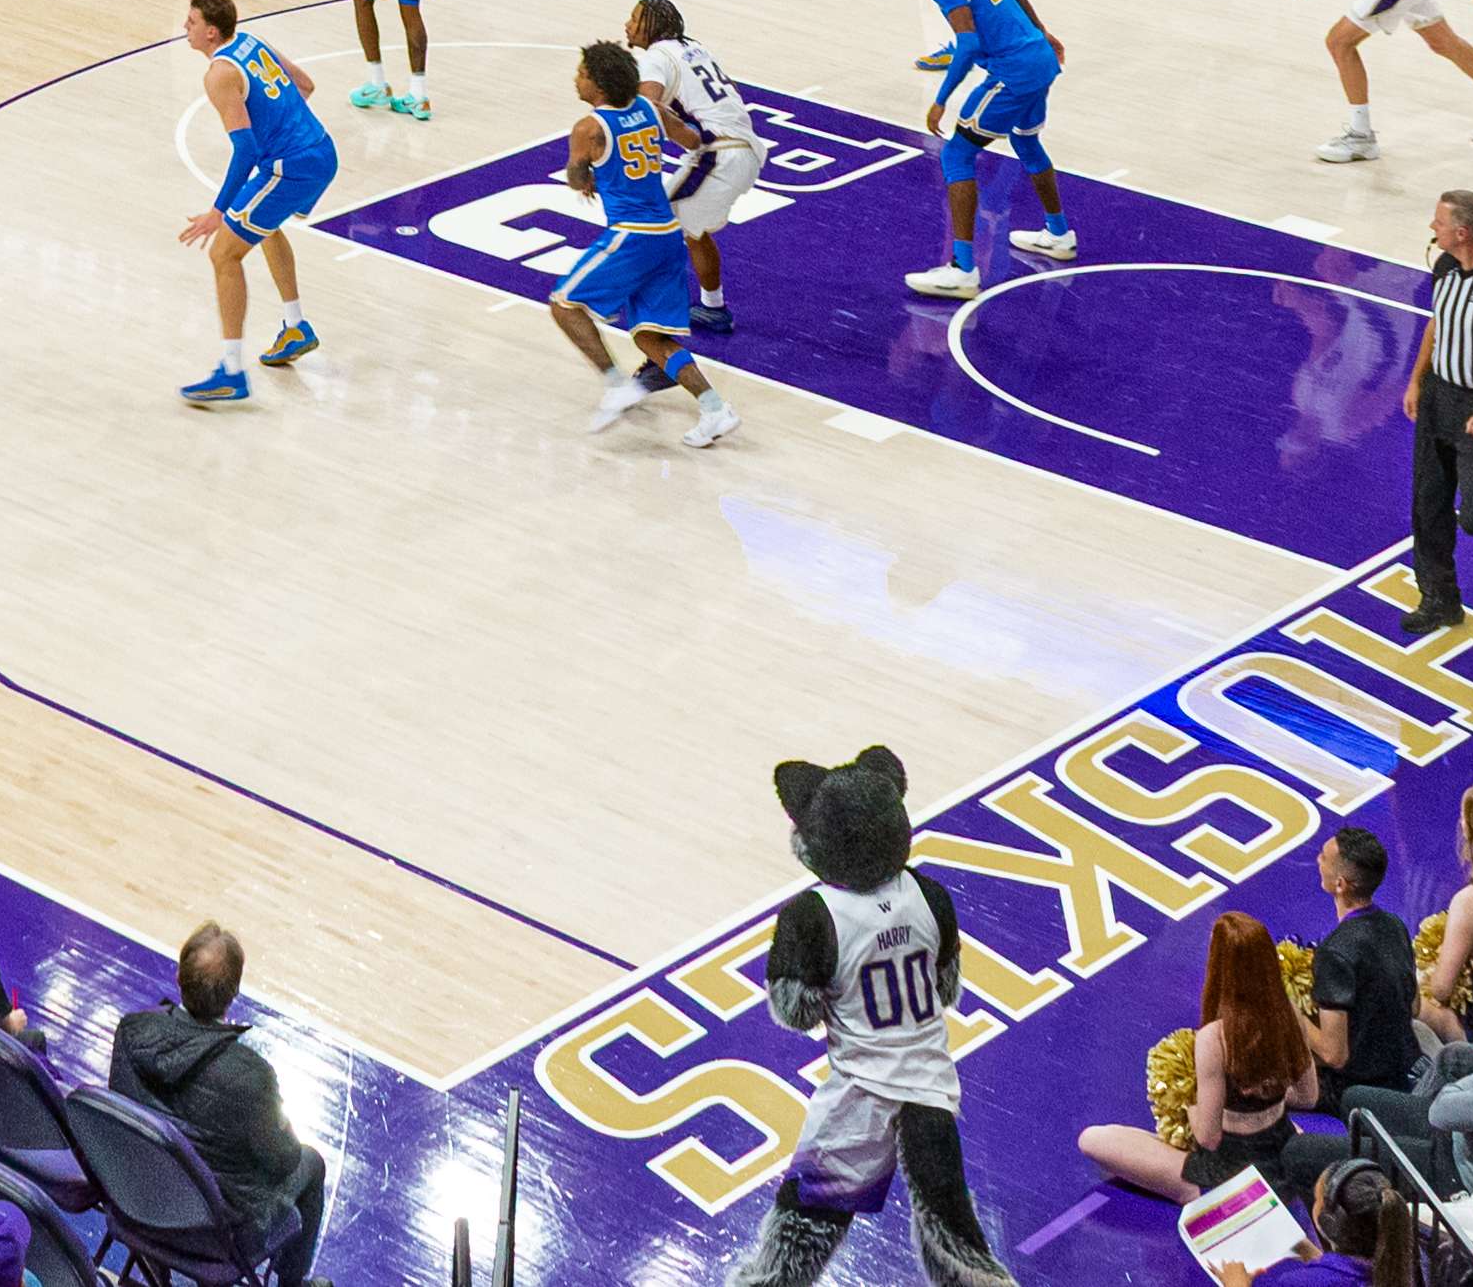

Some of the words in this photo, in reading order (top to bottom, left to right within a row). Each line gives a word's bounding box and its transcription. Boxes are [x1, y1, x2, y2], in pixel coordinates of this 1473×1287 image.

[246, 47, 291, 100] 34
[693, 61, 732, 103] 24
[617, 126, 661, 180] 55
[876, 925, 911, 951] HARRY
[860, 950, 934, 1030] 00
